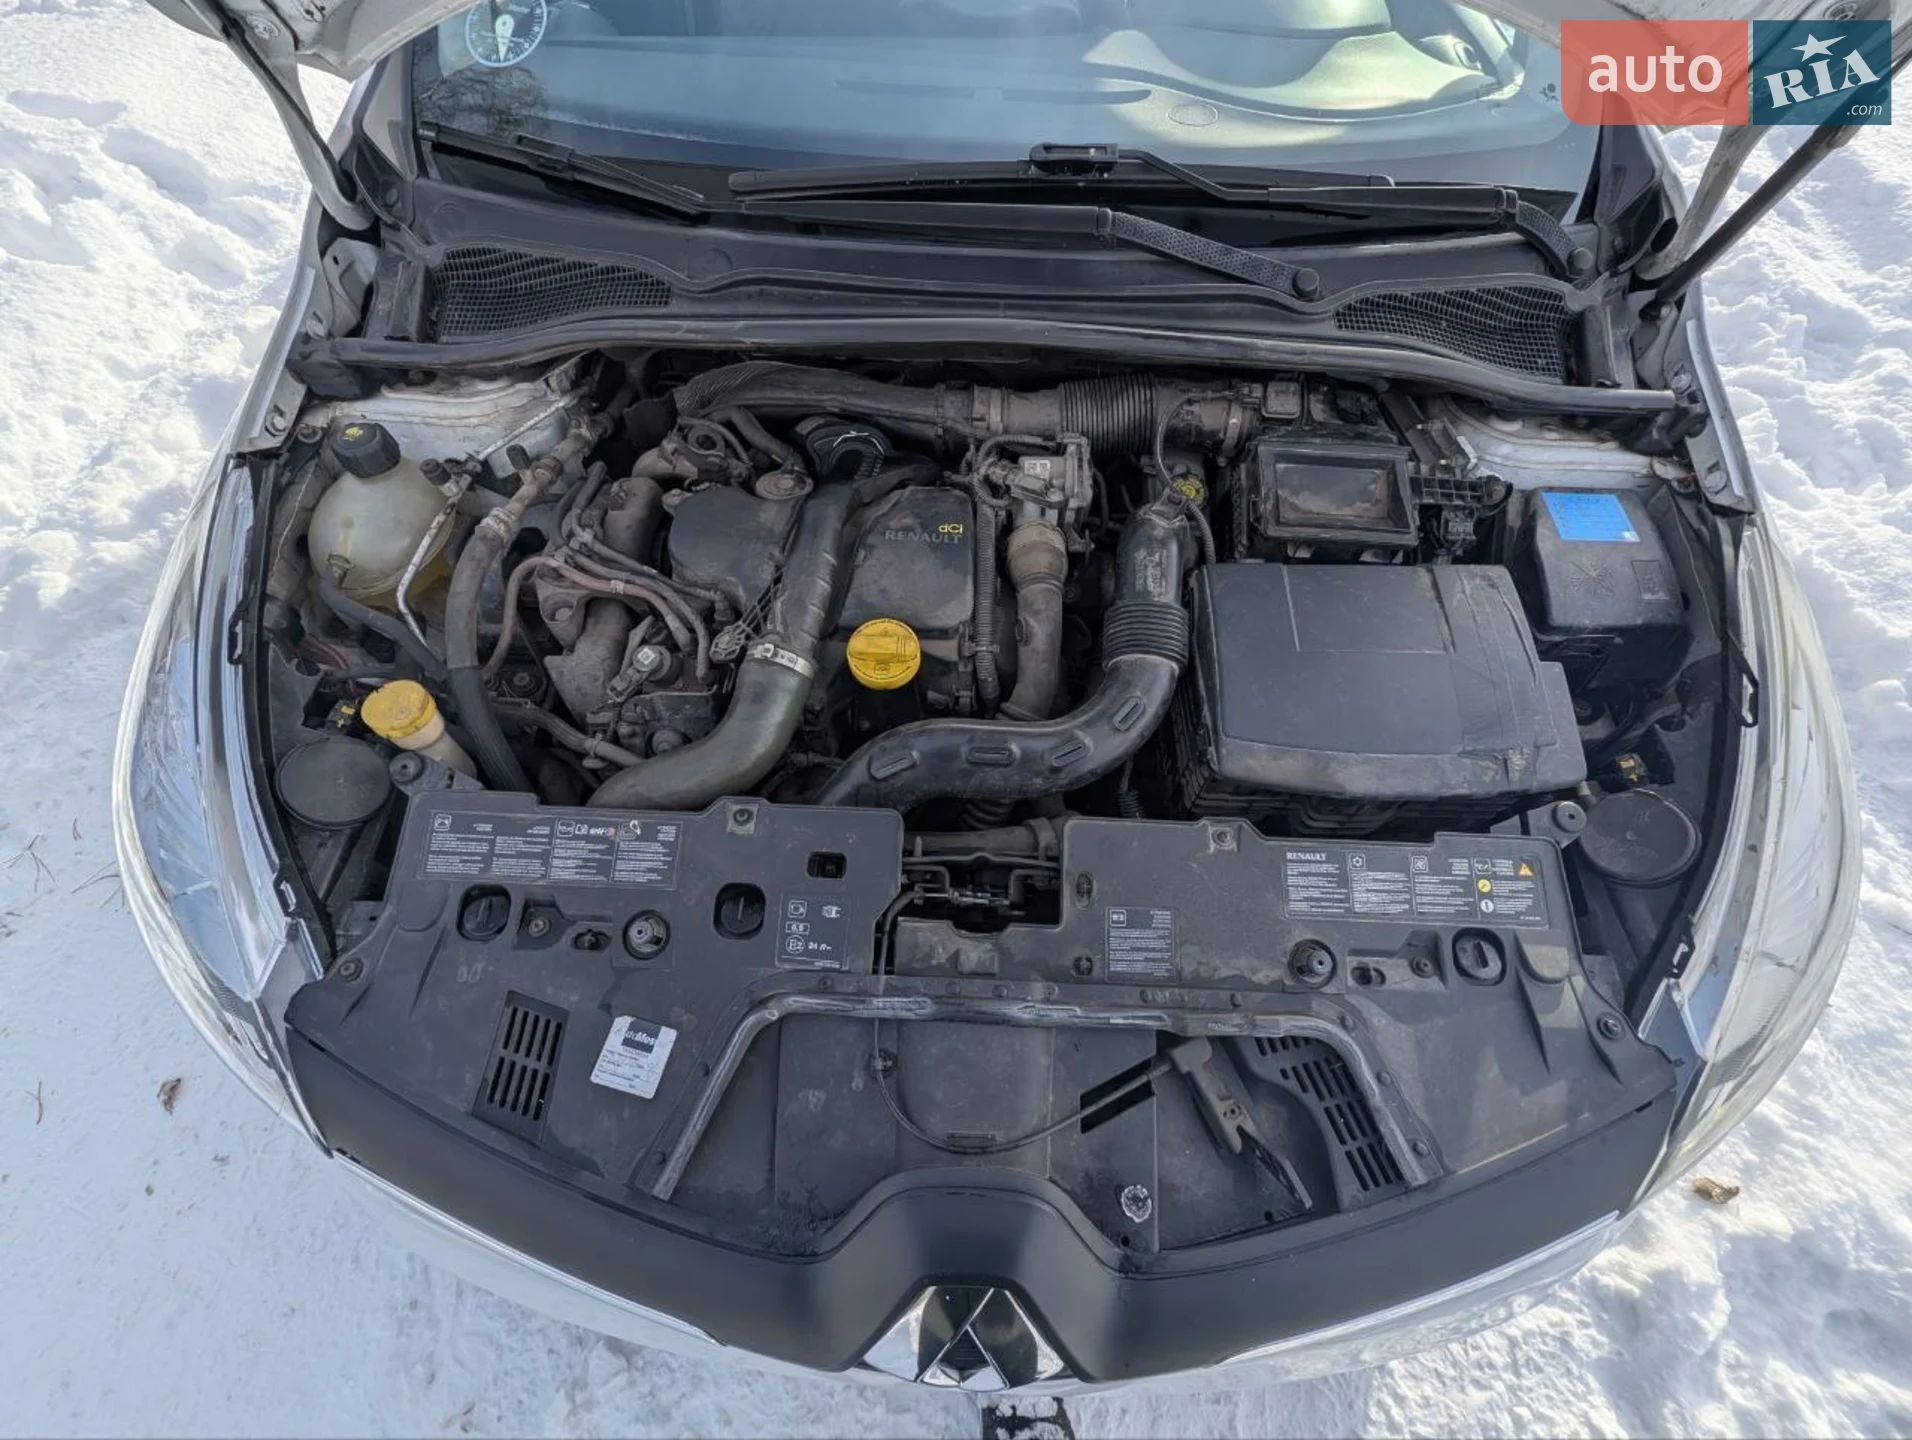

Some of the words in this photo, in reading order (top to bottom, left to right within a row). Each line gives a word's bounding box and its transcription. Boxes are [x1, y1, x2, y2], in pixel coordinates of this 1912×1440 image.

[938, 523, 963, 534] dCi
[885, 530, 963, 544] RENAULT
[1286, 851, 1327, 861] RENAULT
